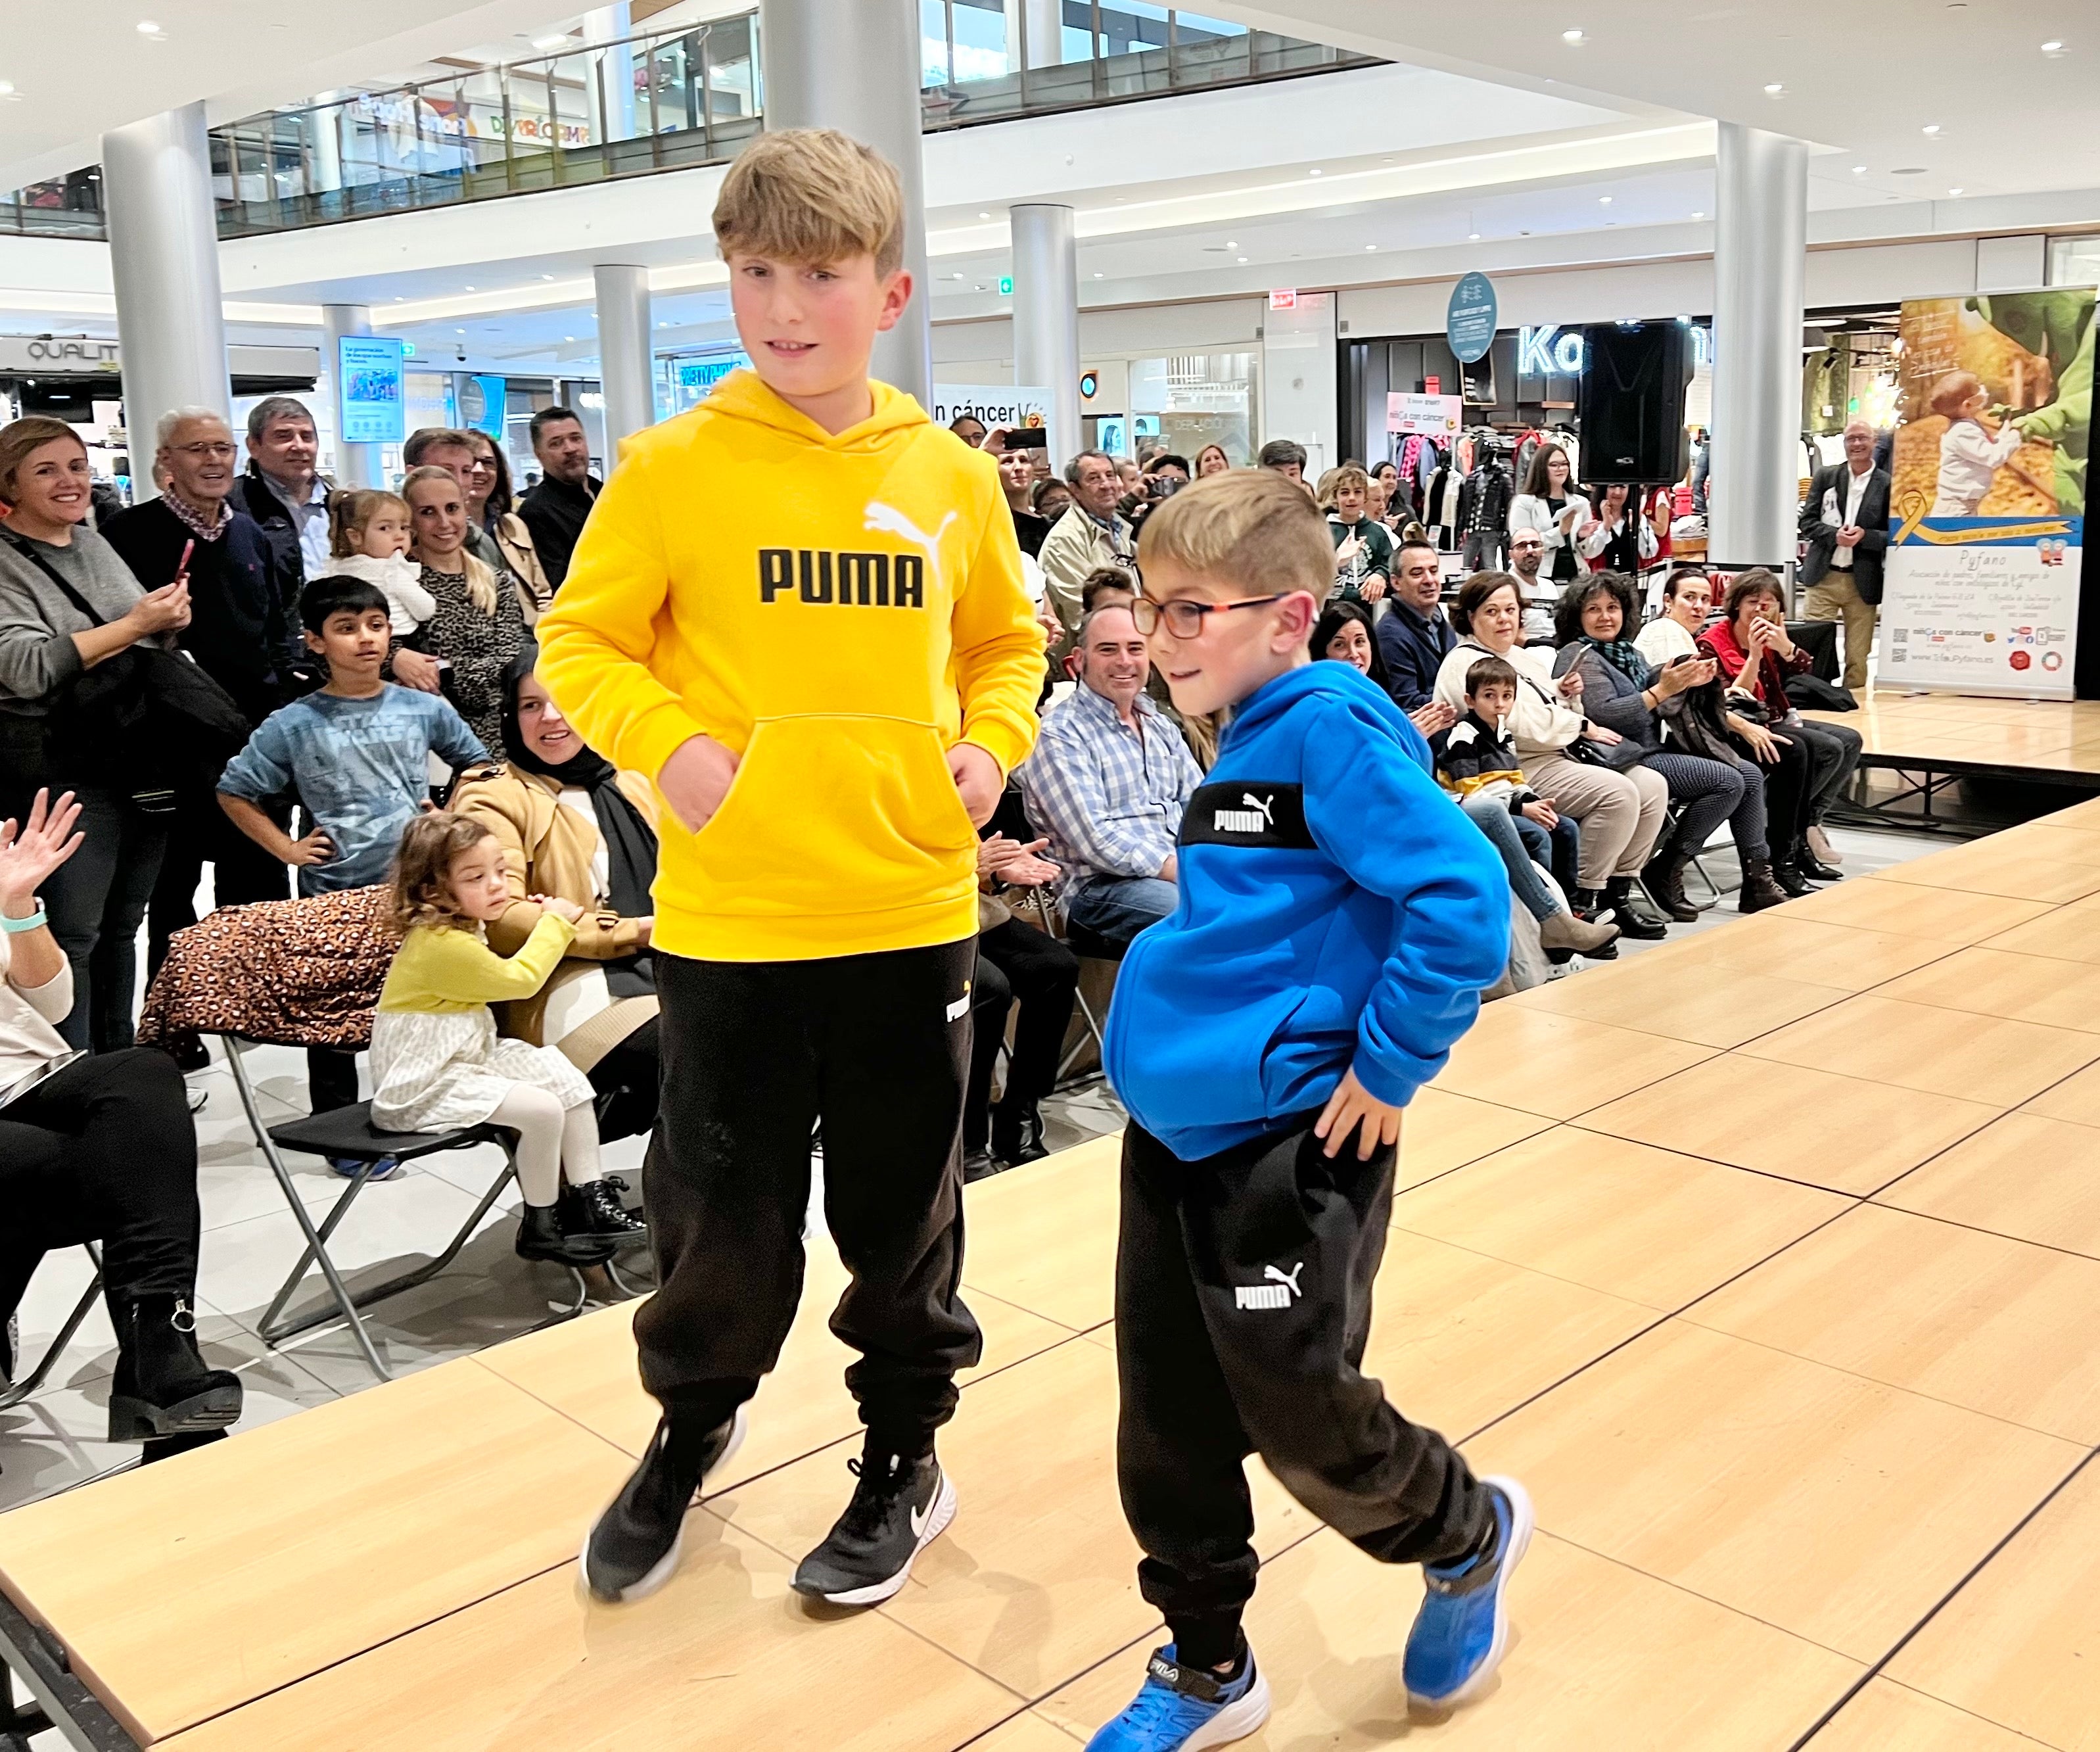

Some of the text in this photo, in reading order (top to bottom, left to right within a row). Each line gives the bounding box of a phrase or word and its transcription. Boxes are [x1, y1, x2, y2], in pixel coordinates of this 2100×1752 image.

[28, 342, 118, 361] QUALIT
[952, 400, 1015, 423] cáncer
[1959, 550, 2007, 571] Pyfano
[759, 549, 923, 608] PUMA
[1214, 810, 1264, 832] PUMA
[1235, 1285, 1292, 1310] PUMA
